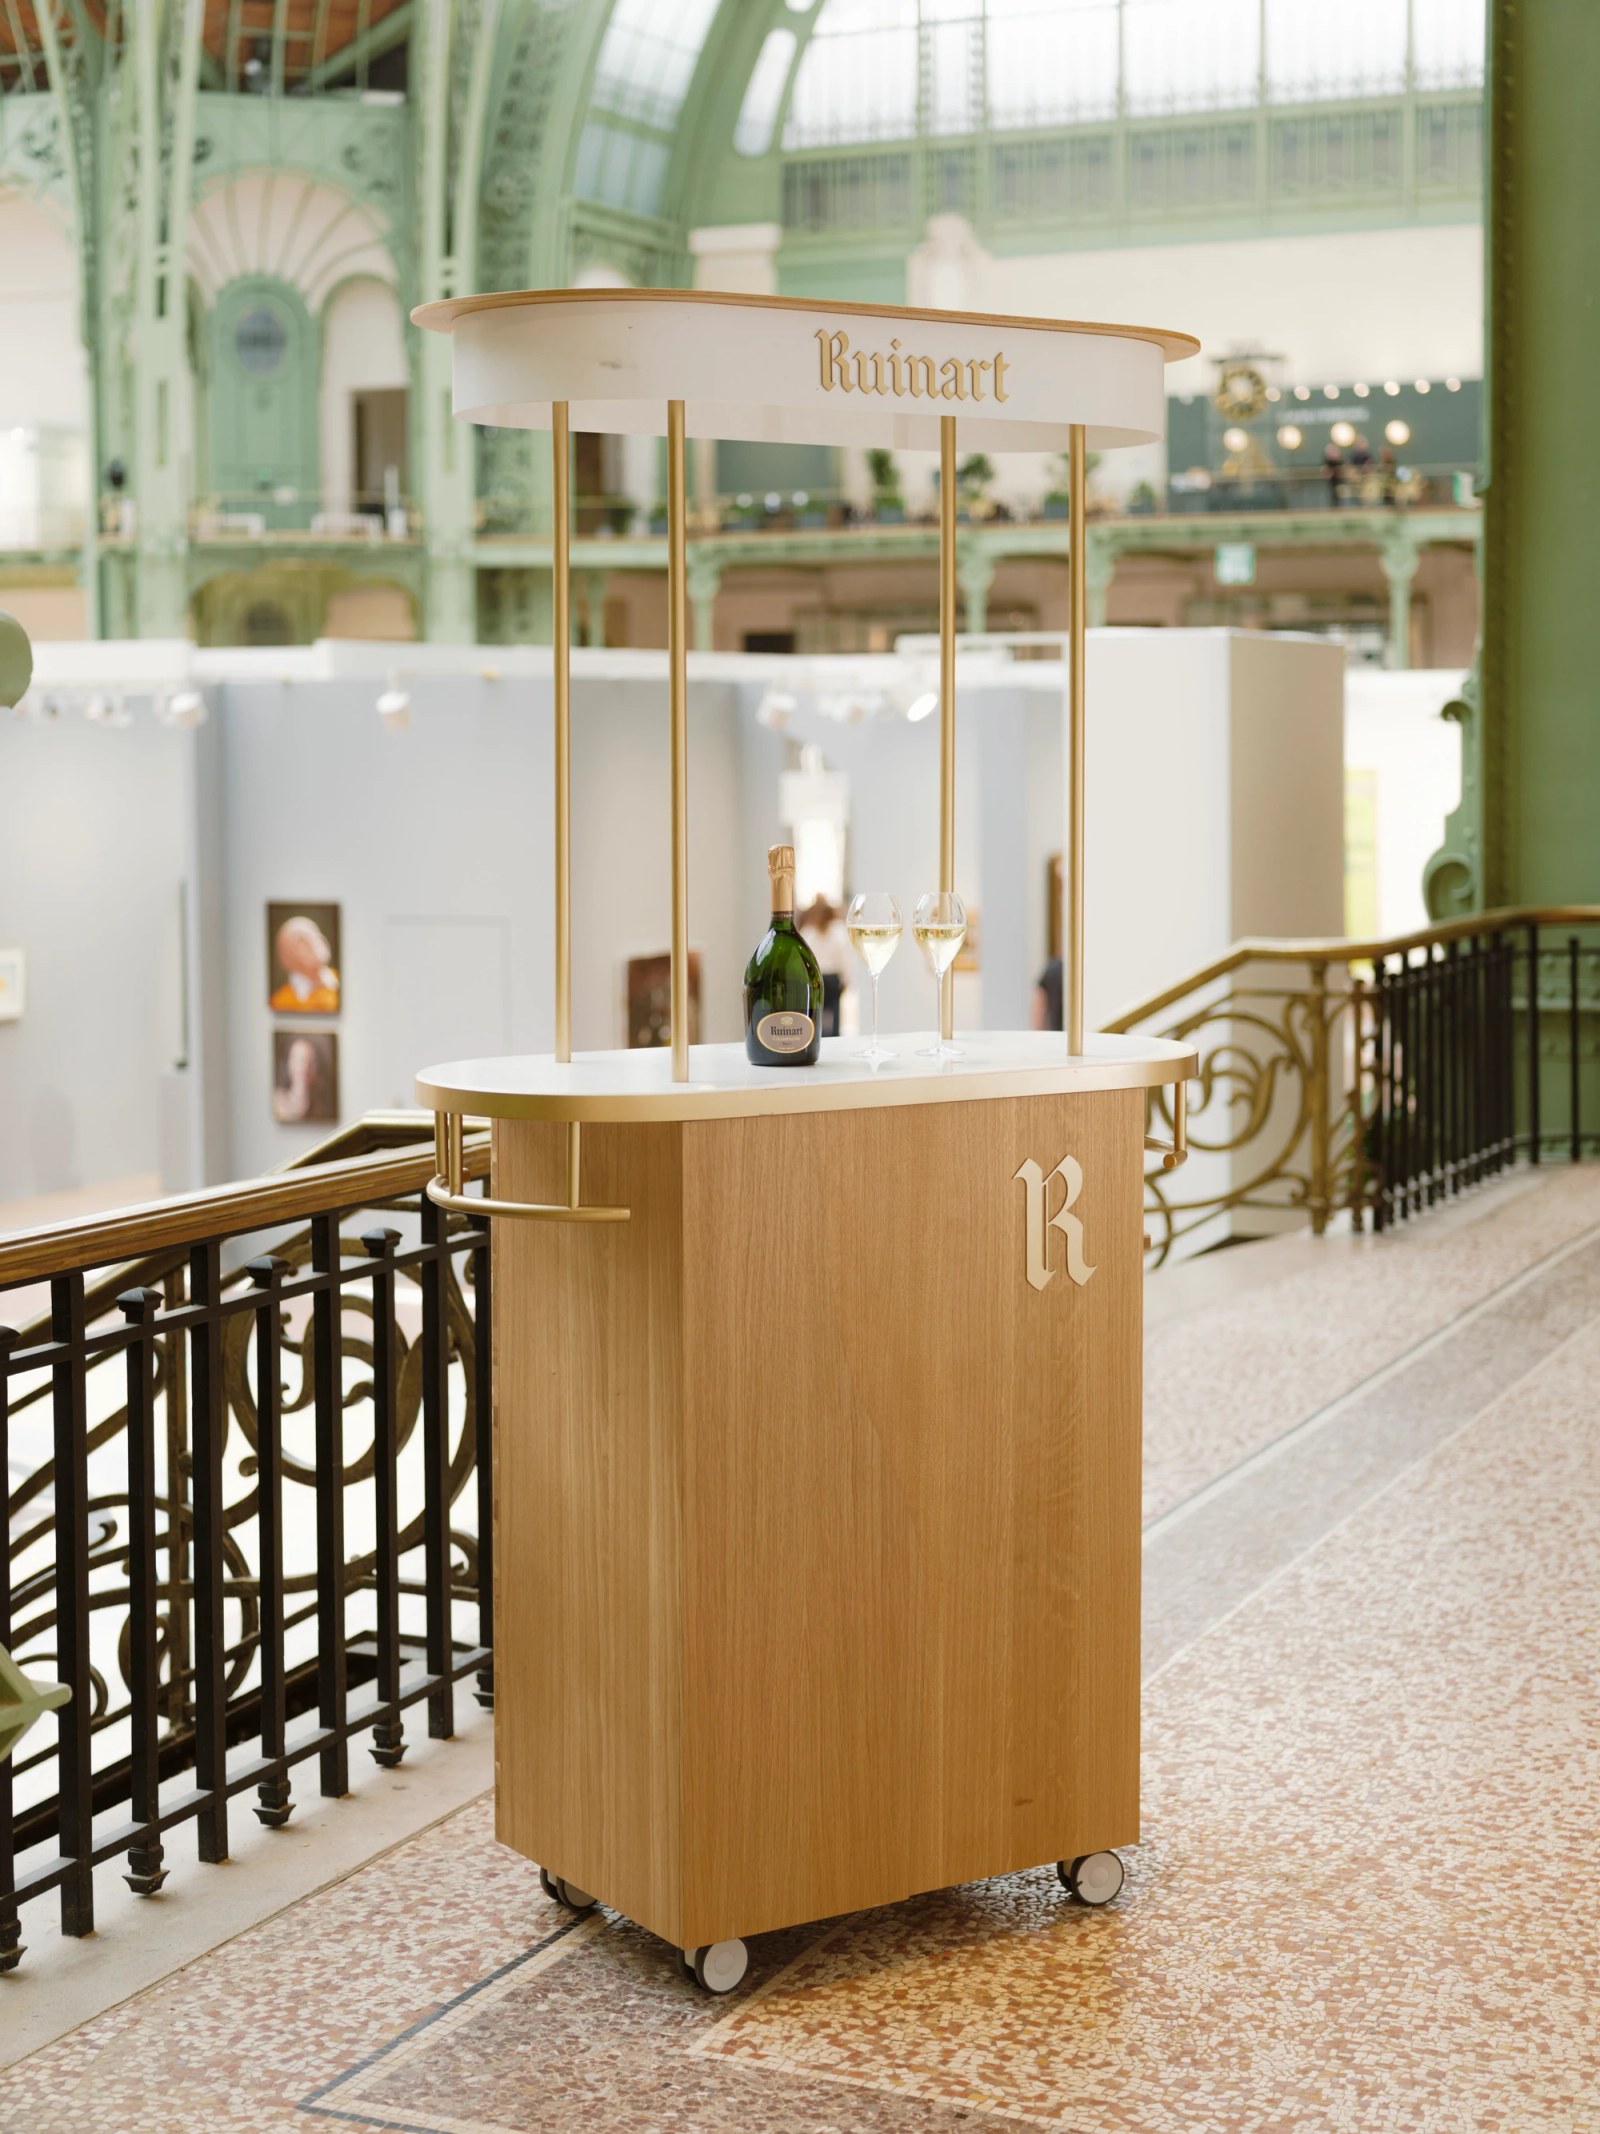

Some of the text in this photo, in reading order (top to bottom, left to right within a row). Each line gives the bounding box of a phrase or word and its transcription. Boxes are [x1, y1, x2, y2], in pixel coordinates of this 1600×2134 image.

[814, 329, 1010, 403] Ruinart
[770, 1025, 803, 1036] Ruinart
[1012, 1154, 1098, 1291] R
